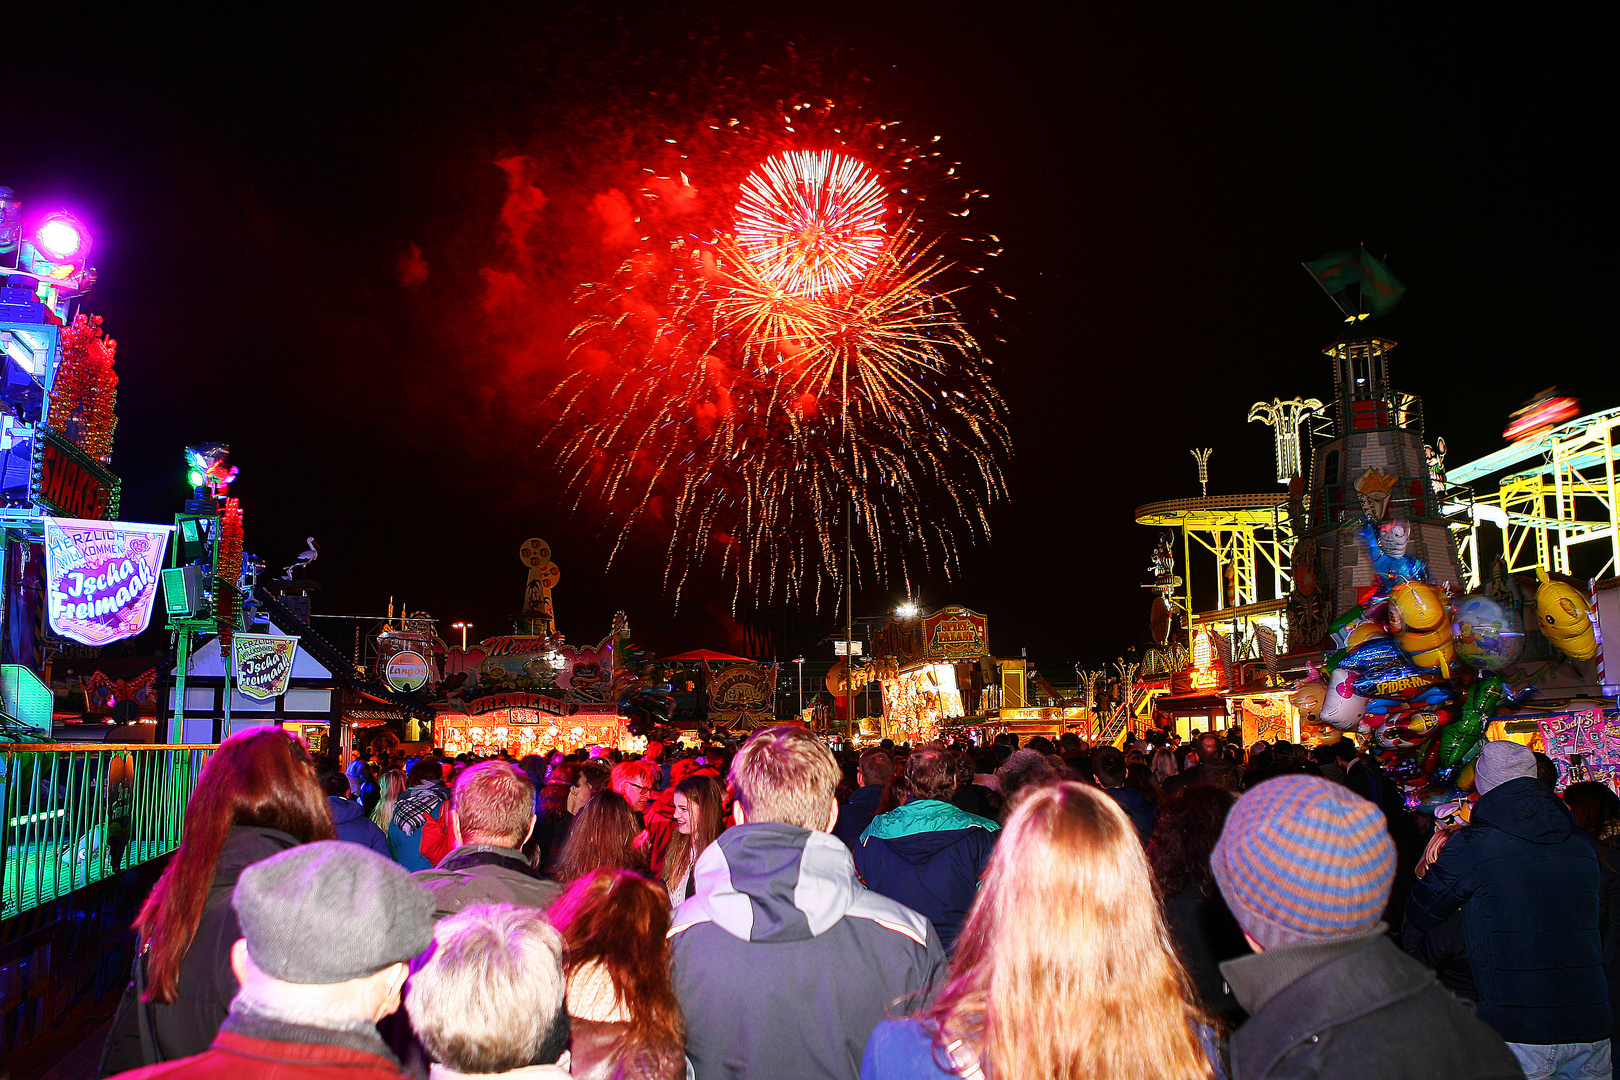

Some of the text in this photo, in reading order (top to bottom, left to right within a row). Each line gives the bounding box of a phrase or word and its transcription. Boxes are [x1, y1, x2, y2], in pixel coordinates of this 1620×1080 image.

[40, 444, 108, 520] SHAKER
[48, 530, 125, 556] HERZLICH
[472, 693, 566, 716] BRENNEREI
[1037, 710, 1050, 718] BIG
